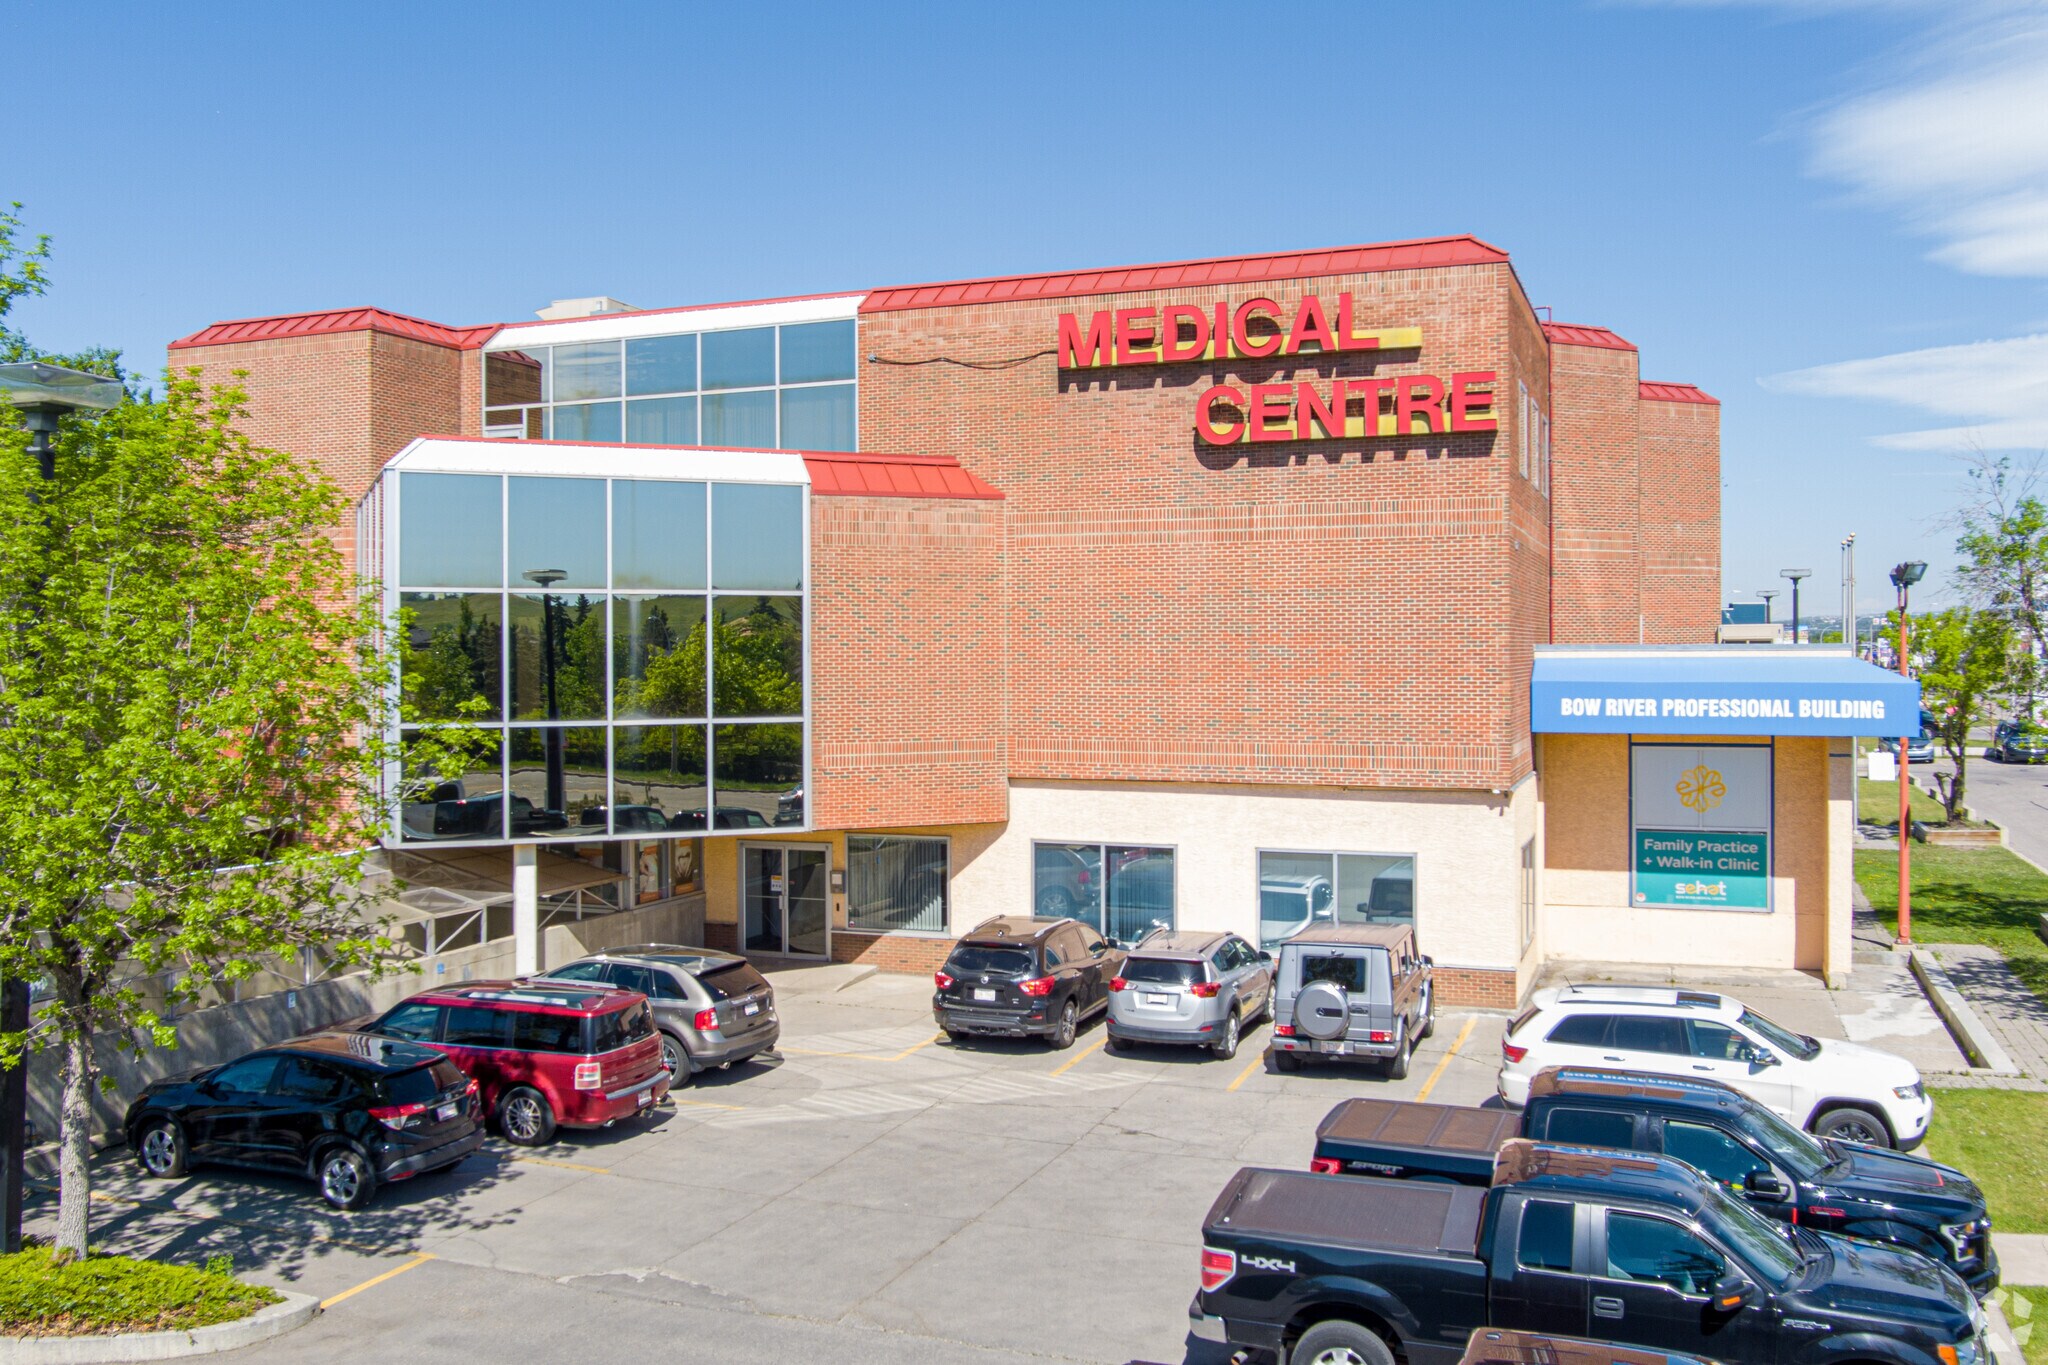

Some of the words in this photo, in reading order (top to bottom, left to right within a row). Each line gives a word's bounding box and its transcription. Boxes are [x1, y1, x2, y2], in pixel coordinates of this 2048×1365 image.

[1058, 292, 1380, 369] MEDICAL
[1195, 371, 1498, 446] CENTRE
[1561, 698, 1601, 716] BOW
[1605, 698, 1657, 717] RIVER
[1662, 698, 1794, 718] PROFESSIONAL
[1799, 699, 1885, 719] BUILDING
[1643, 838, 1694, 854] Family
[1697, 840, 1759, 854] Practice
[1643, 856, 1653, 866] +
[1656, 855, 1714, 869] Walk-in
[1717, 857, 1760, 871] Clinic
[1347, 1160, 1404, 1176] SPORT
